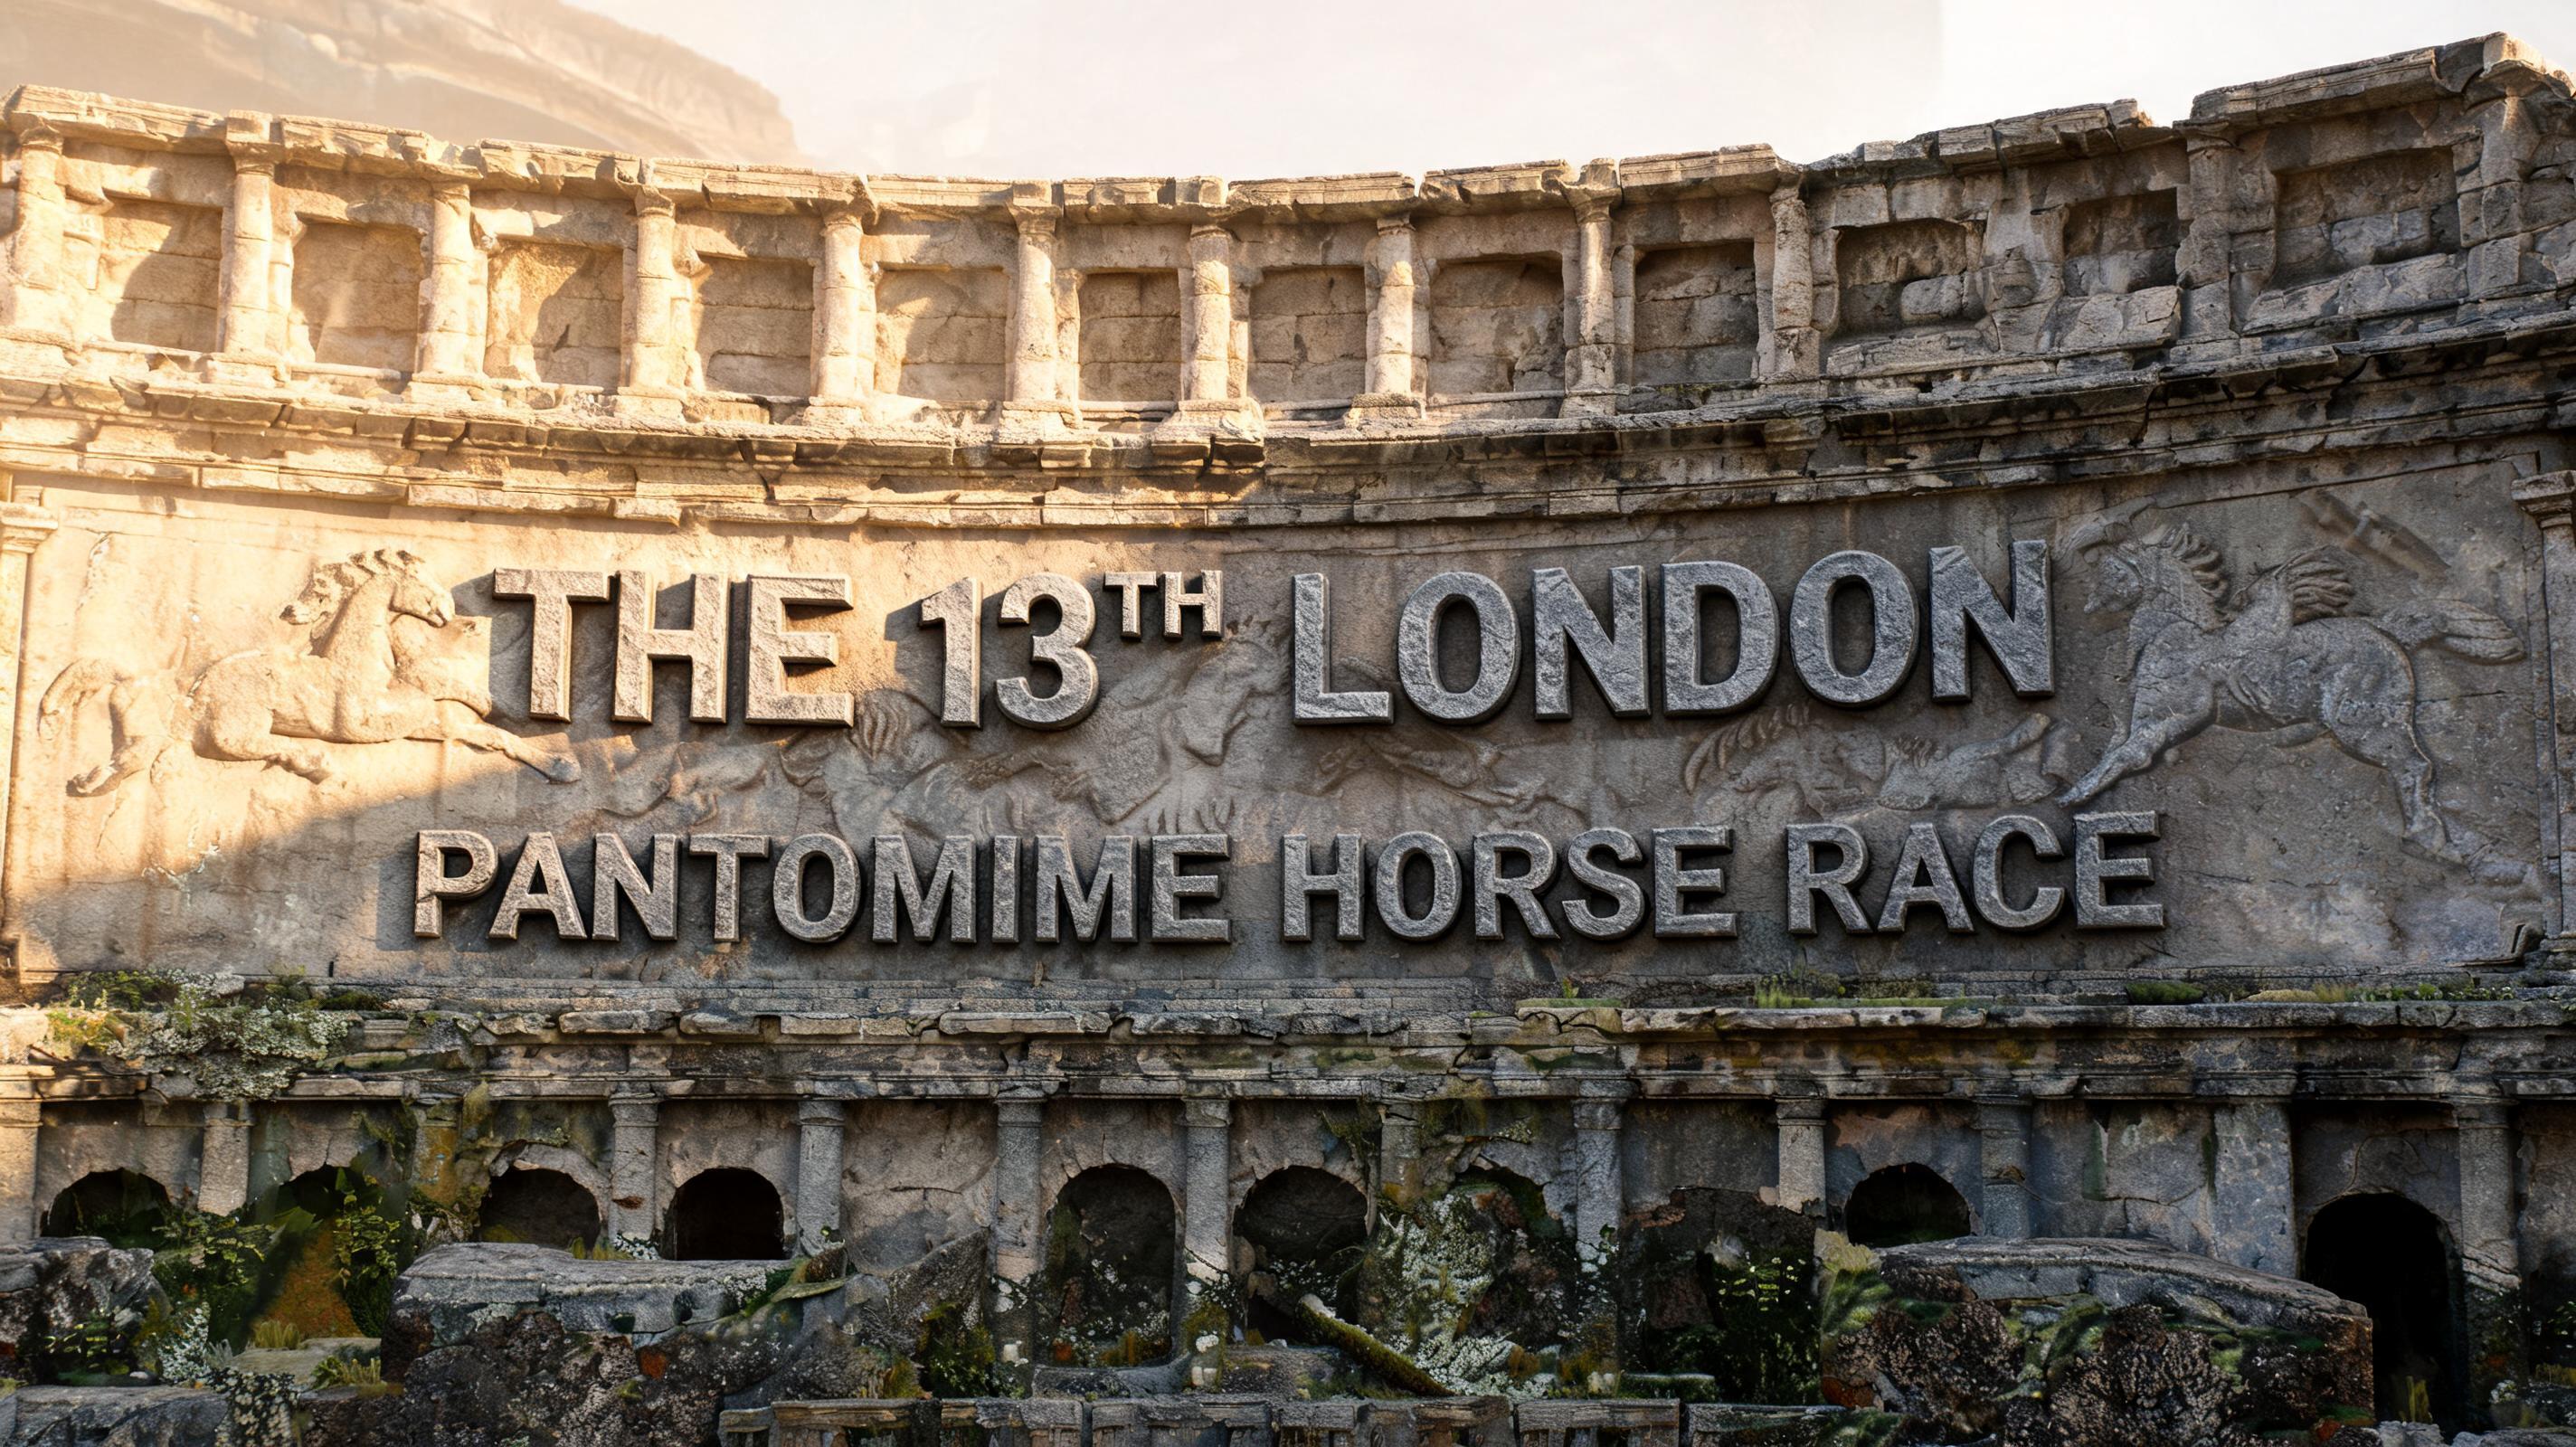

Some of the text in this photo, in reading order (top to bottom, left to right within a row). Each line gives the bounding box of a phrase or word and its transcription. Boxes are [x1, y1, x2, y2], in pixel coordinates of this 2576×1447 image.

[494, 540, 2056, 731] THE 13TH LONDON
[413, 809, 2165, 945] PANTOMIME HORSE RACE
